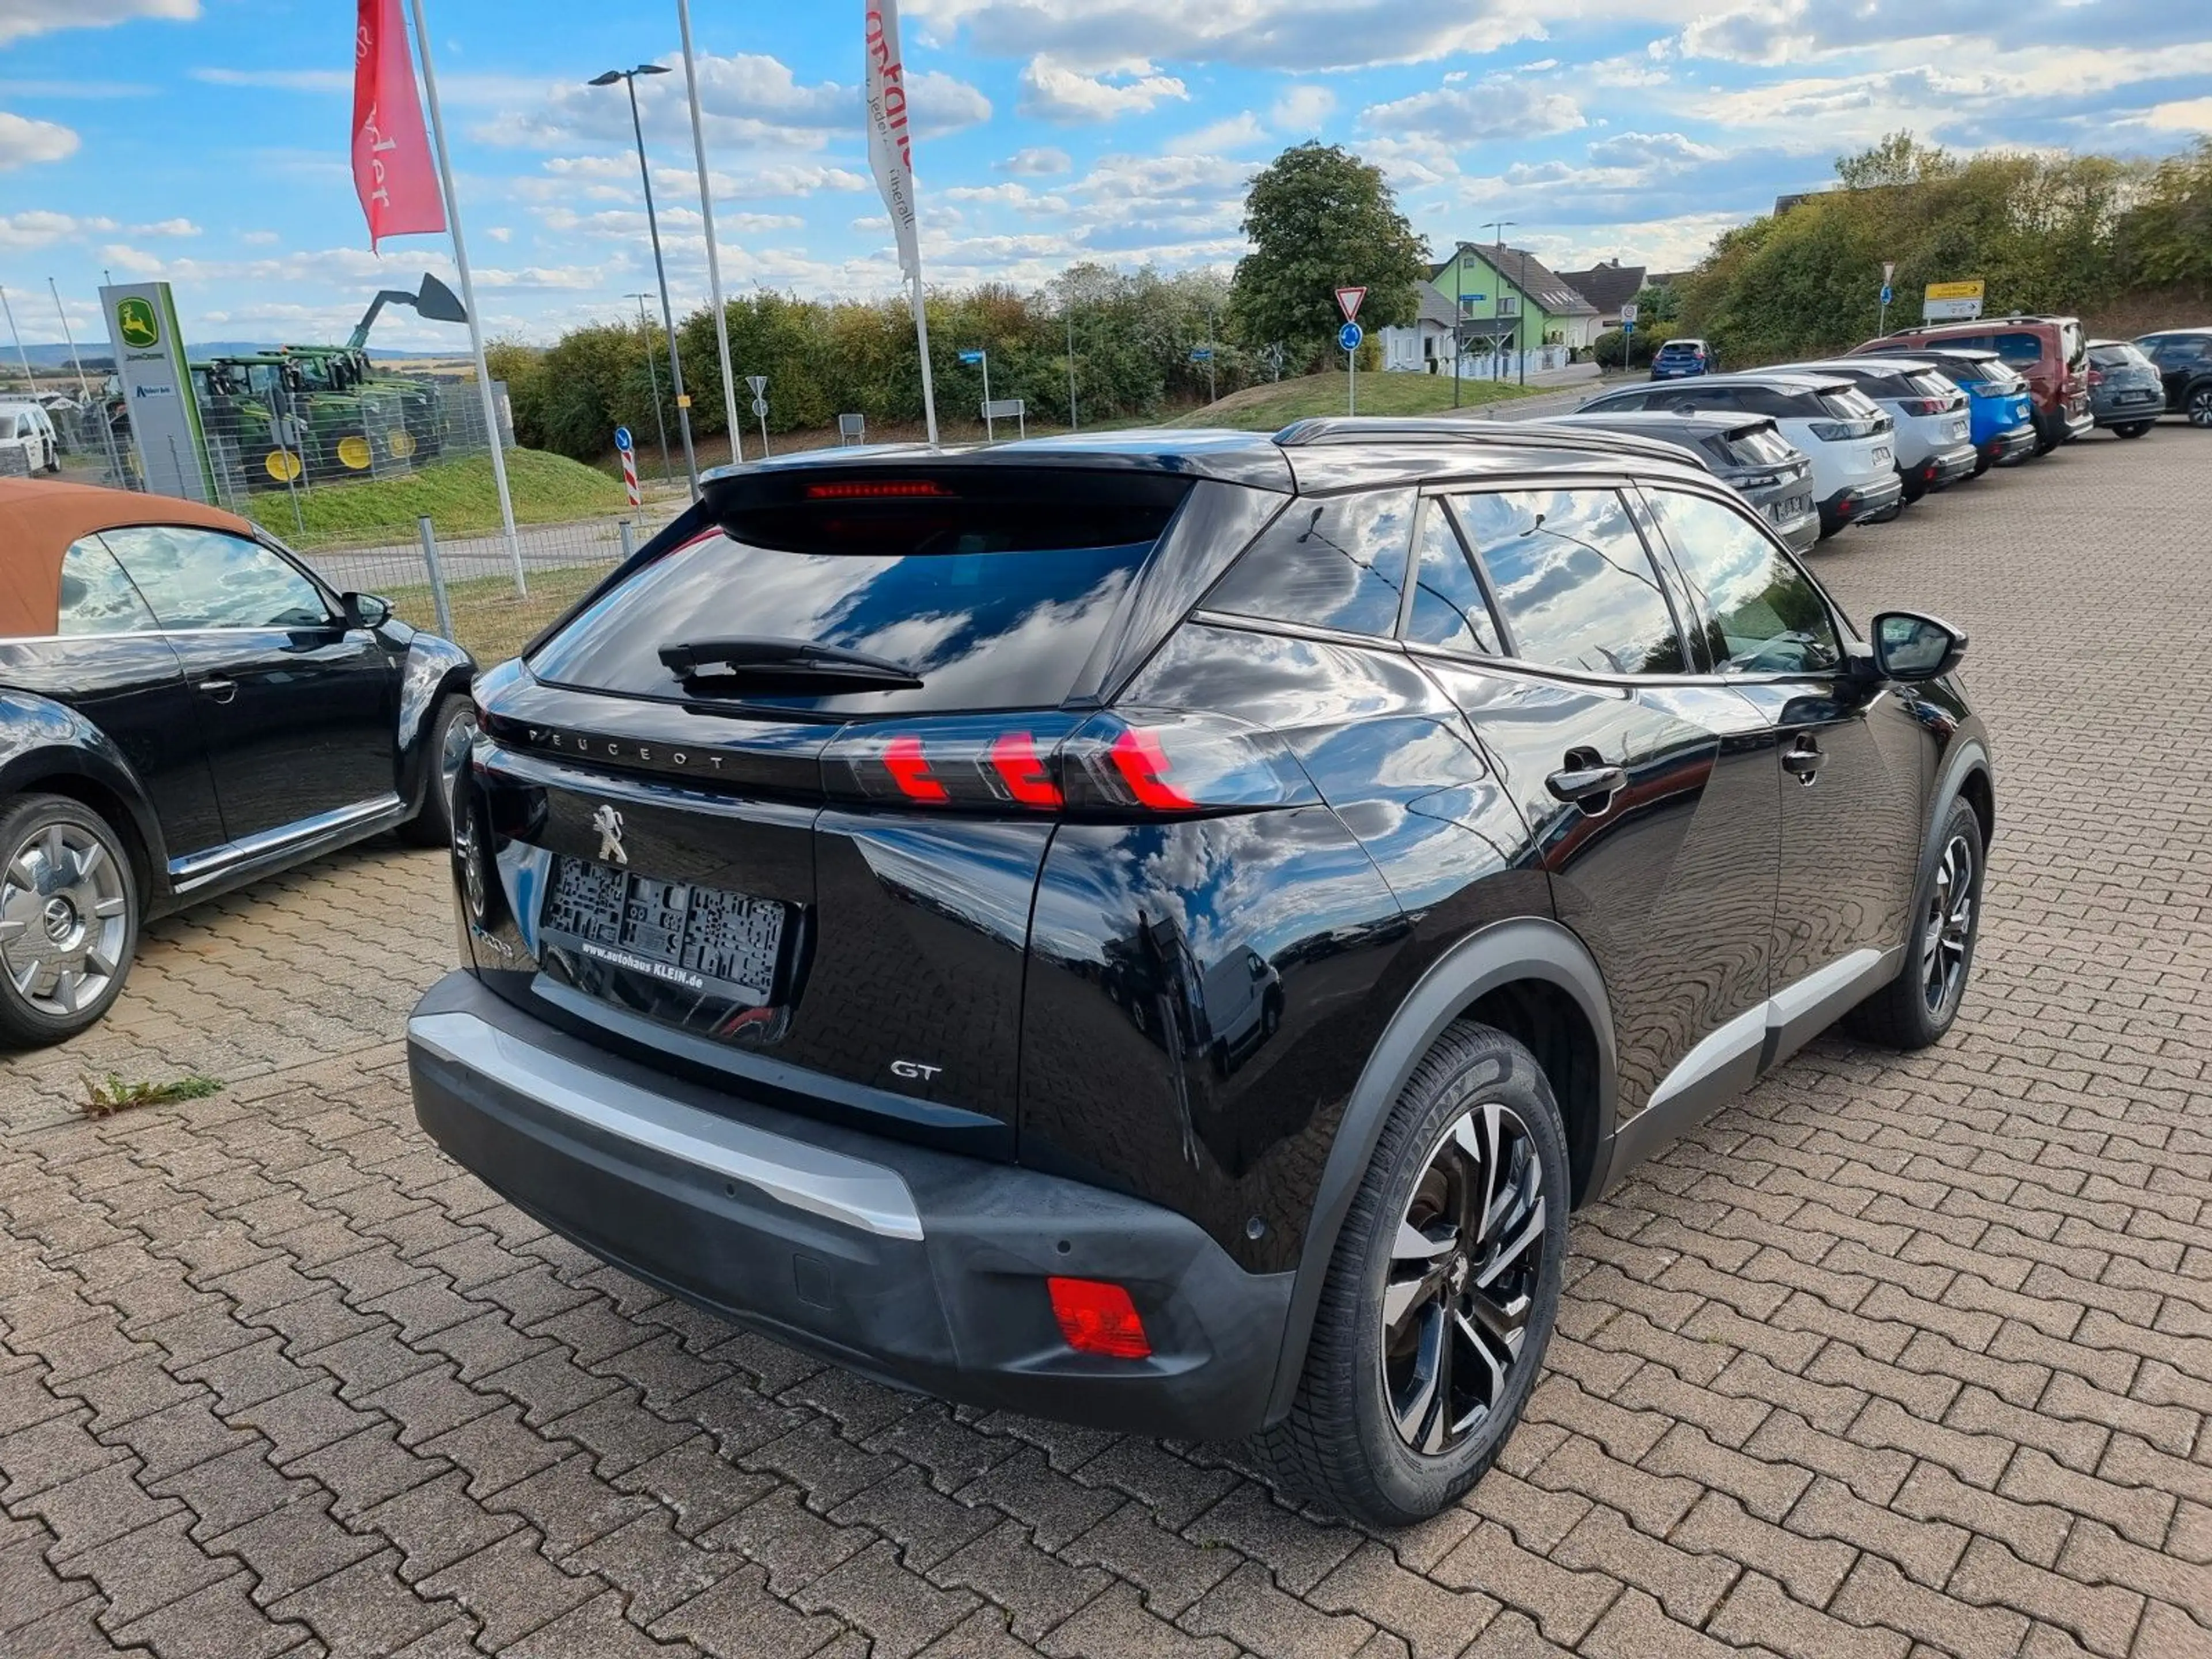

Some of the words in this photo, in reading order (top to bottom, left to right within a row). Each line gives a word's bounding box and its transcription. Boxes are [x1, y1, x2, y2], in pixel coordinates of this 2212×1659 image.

[529, 729, 722, 769] PEUGEOT
[582, 943, 651, 973] www.autohaus
[653, 963, 703, 988] KLEIN.de
[891, 1060, 942, 1081] GT
